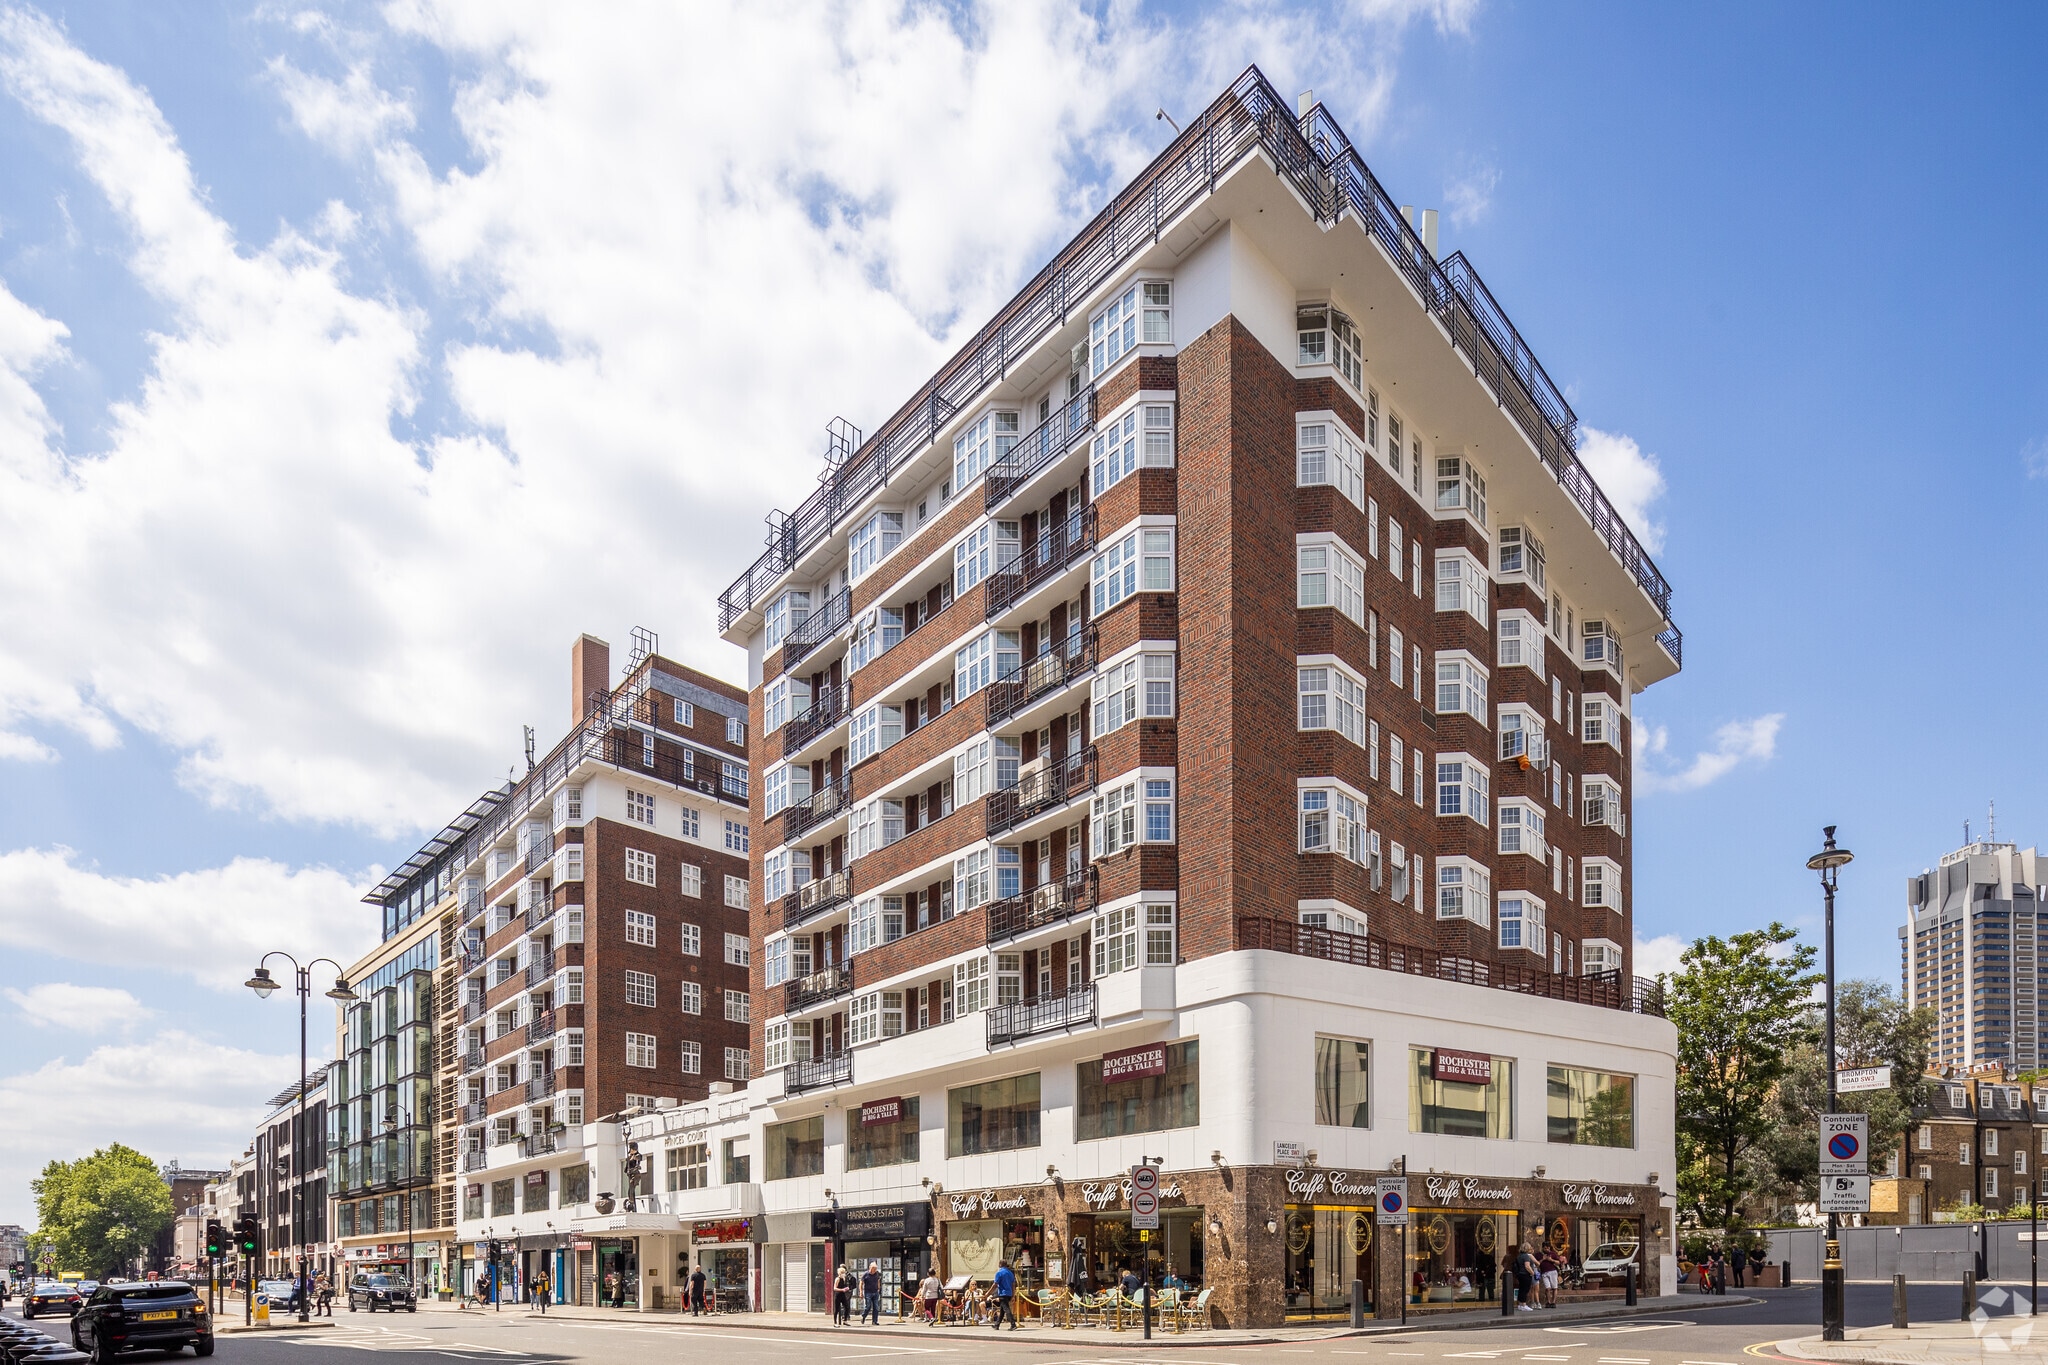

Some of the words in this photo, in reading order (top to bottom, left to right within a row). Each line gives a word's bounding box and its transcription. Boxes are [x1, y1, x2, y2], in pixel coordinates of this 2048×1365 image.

[1104, 1050, 1162, 1069] ROCHESTER
[1439, 1056, 1490, 1070] ROCHESTER
[1112, 1066, 1126, 1075] BIG
[1127, 1064, 1133, 1072] &
[1134, 1061, 1153, 1070] TALL
[1467, 1068, 1482, 1076] TALL
[1841, 1069, 1878, 1078] BROMPTON
[862, 1102, 898, 1116] ROCHESTER
[881, 1110, 892, 1118] TALL
[687, 1130, 707, 1142] COURT
[1329, 1171, 1377, 1196] Concer
[1463, 1177, 1512, 1200] Concerto
[981, 1191, 1026, 1211] Concerto
[1593, 1184, 1635, 1206] Concerto
[847, 1209, 876, 1220] HARRODS
[878, 1208, 904, 1217] ESTATES
